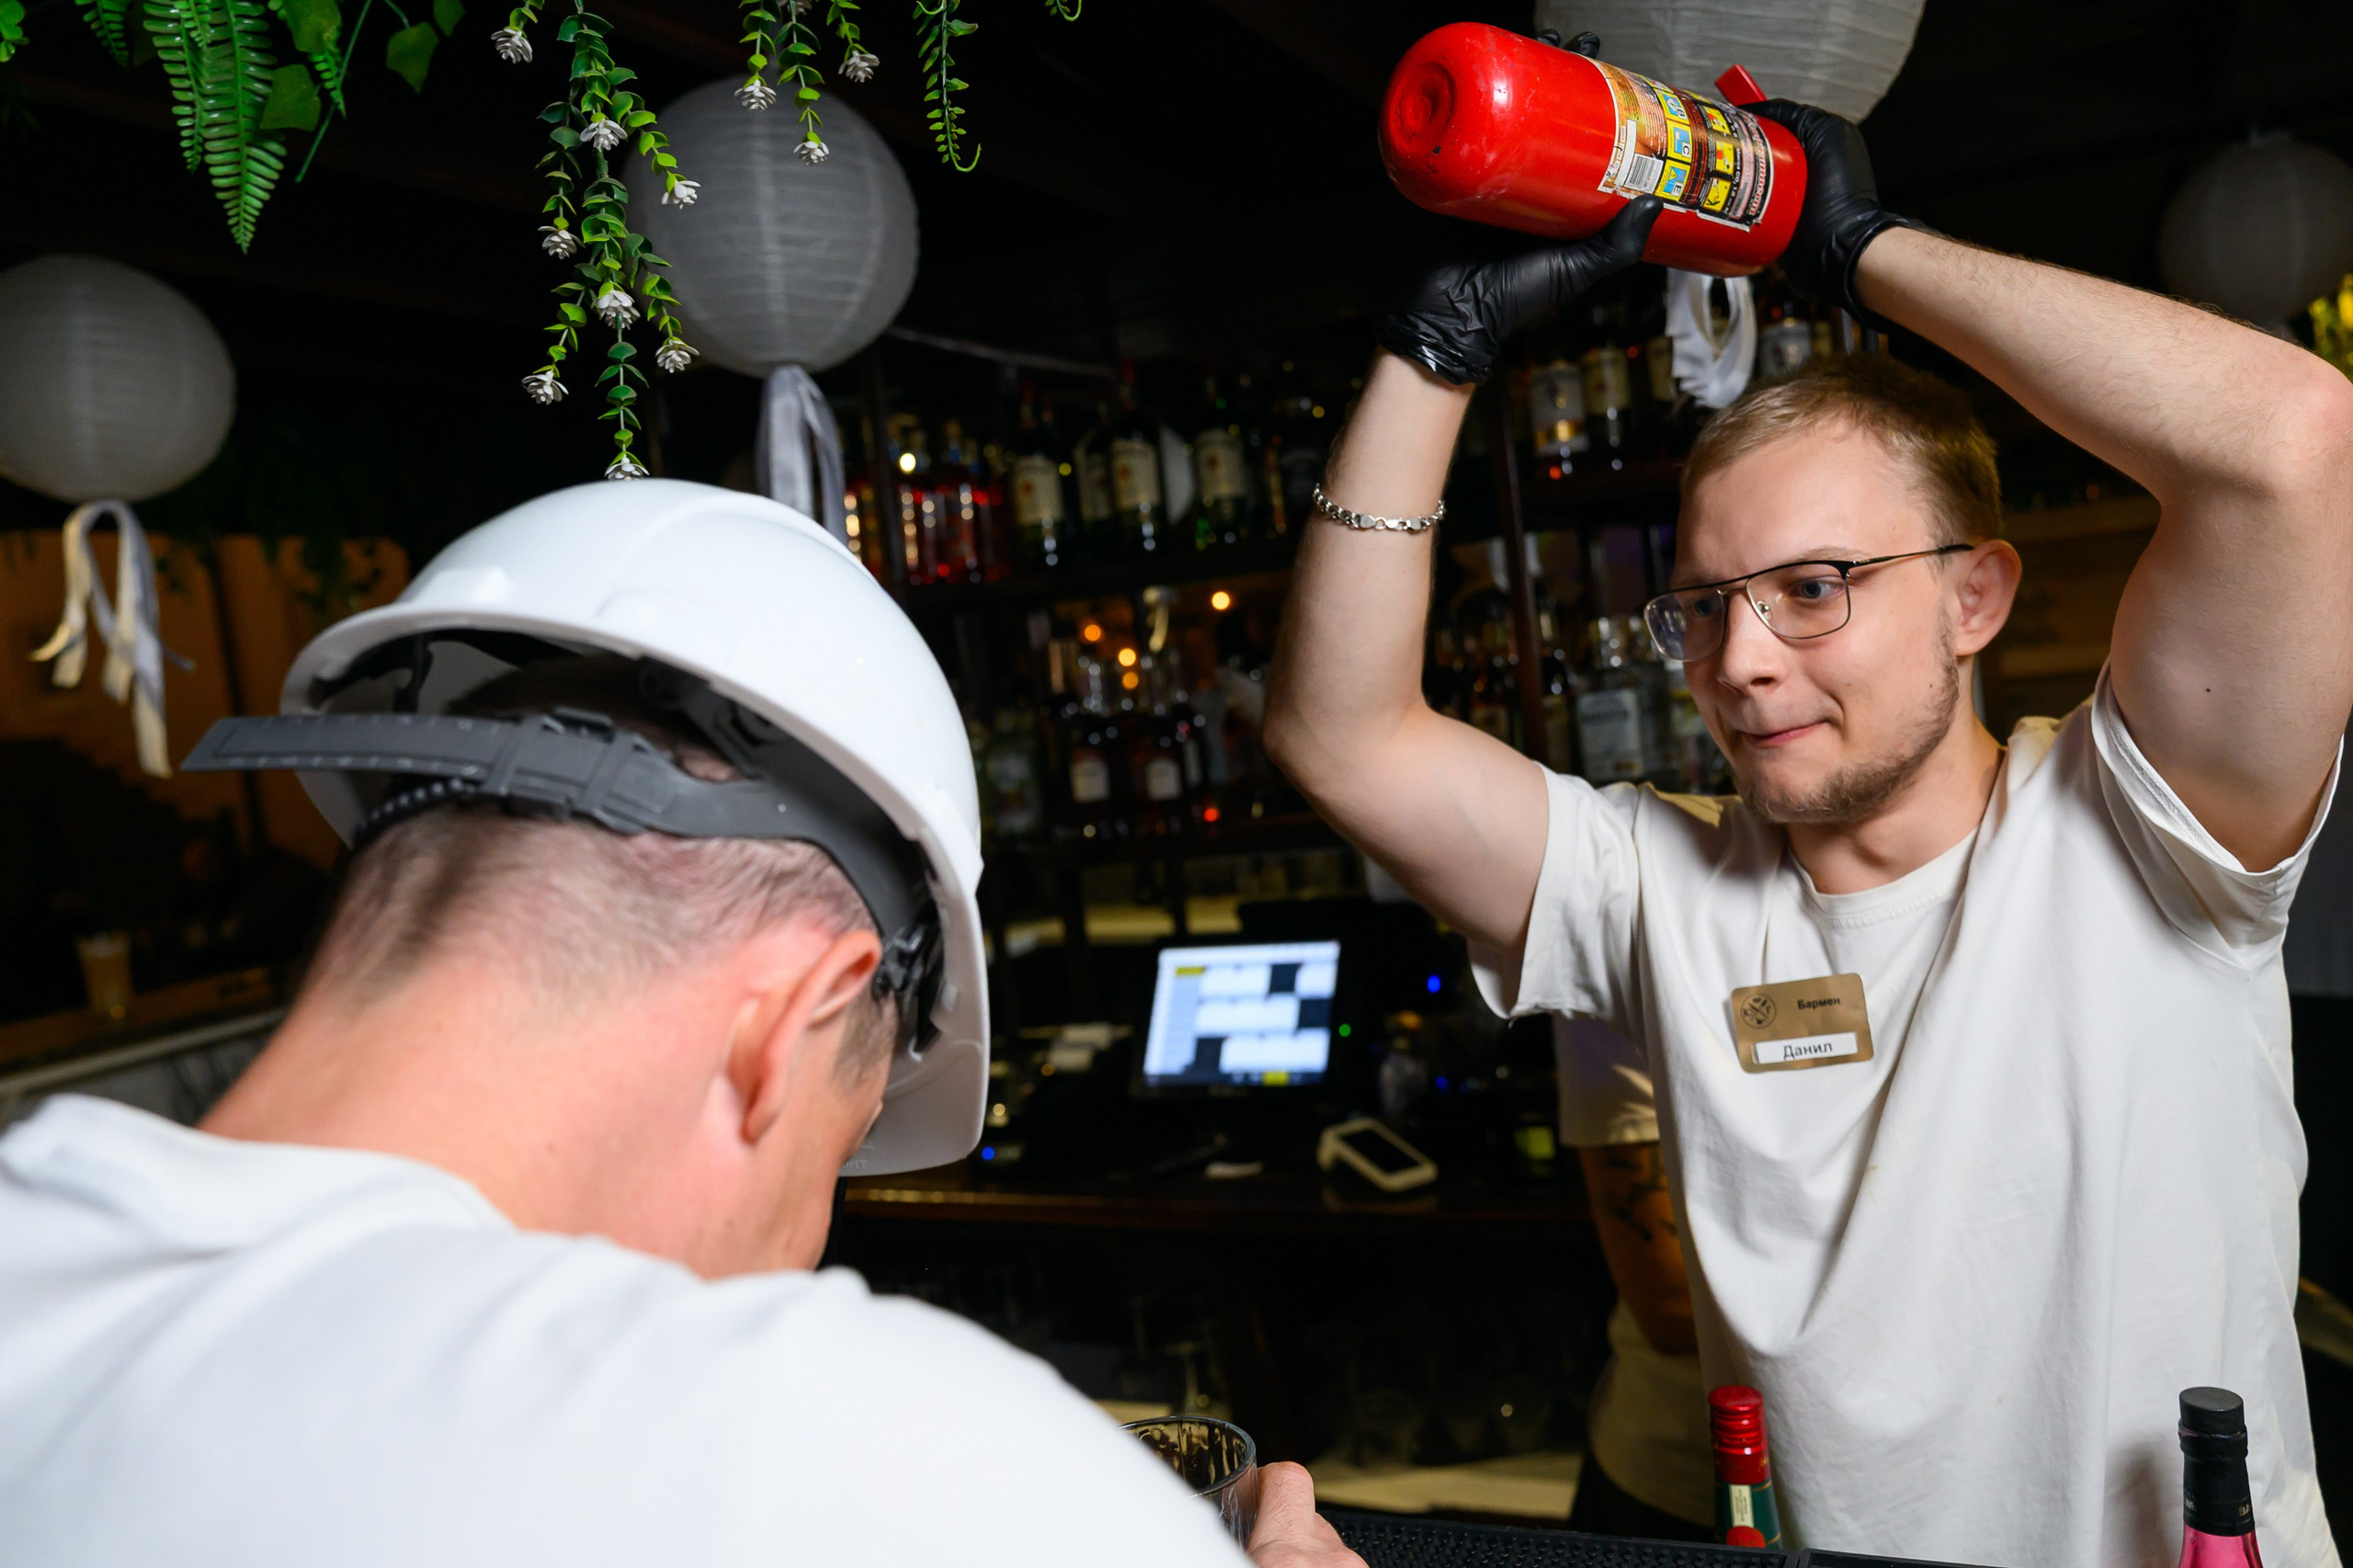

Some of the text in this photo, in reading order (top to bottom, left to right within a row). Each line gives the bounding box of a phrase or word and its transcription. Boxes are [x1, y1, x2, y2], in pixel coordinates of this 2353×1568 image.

[1677, 108, 1686, 117] B
[1682, 145, 1690, 155] C
[1674, 185, 1682, 194] E
[1797, 998, 1841, 1010] Бармен
[1783, 1043, 1832, 1060] Данил
